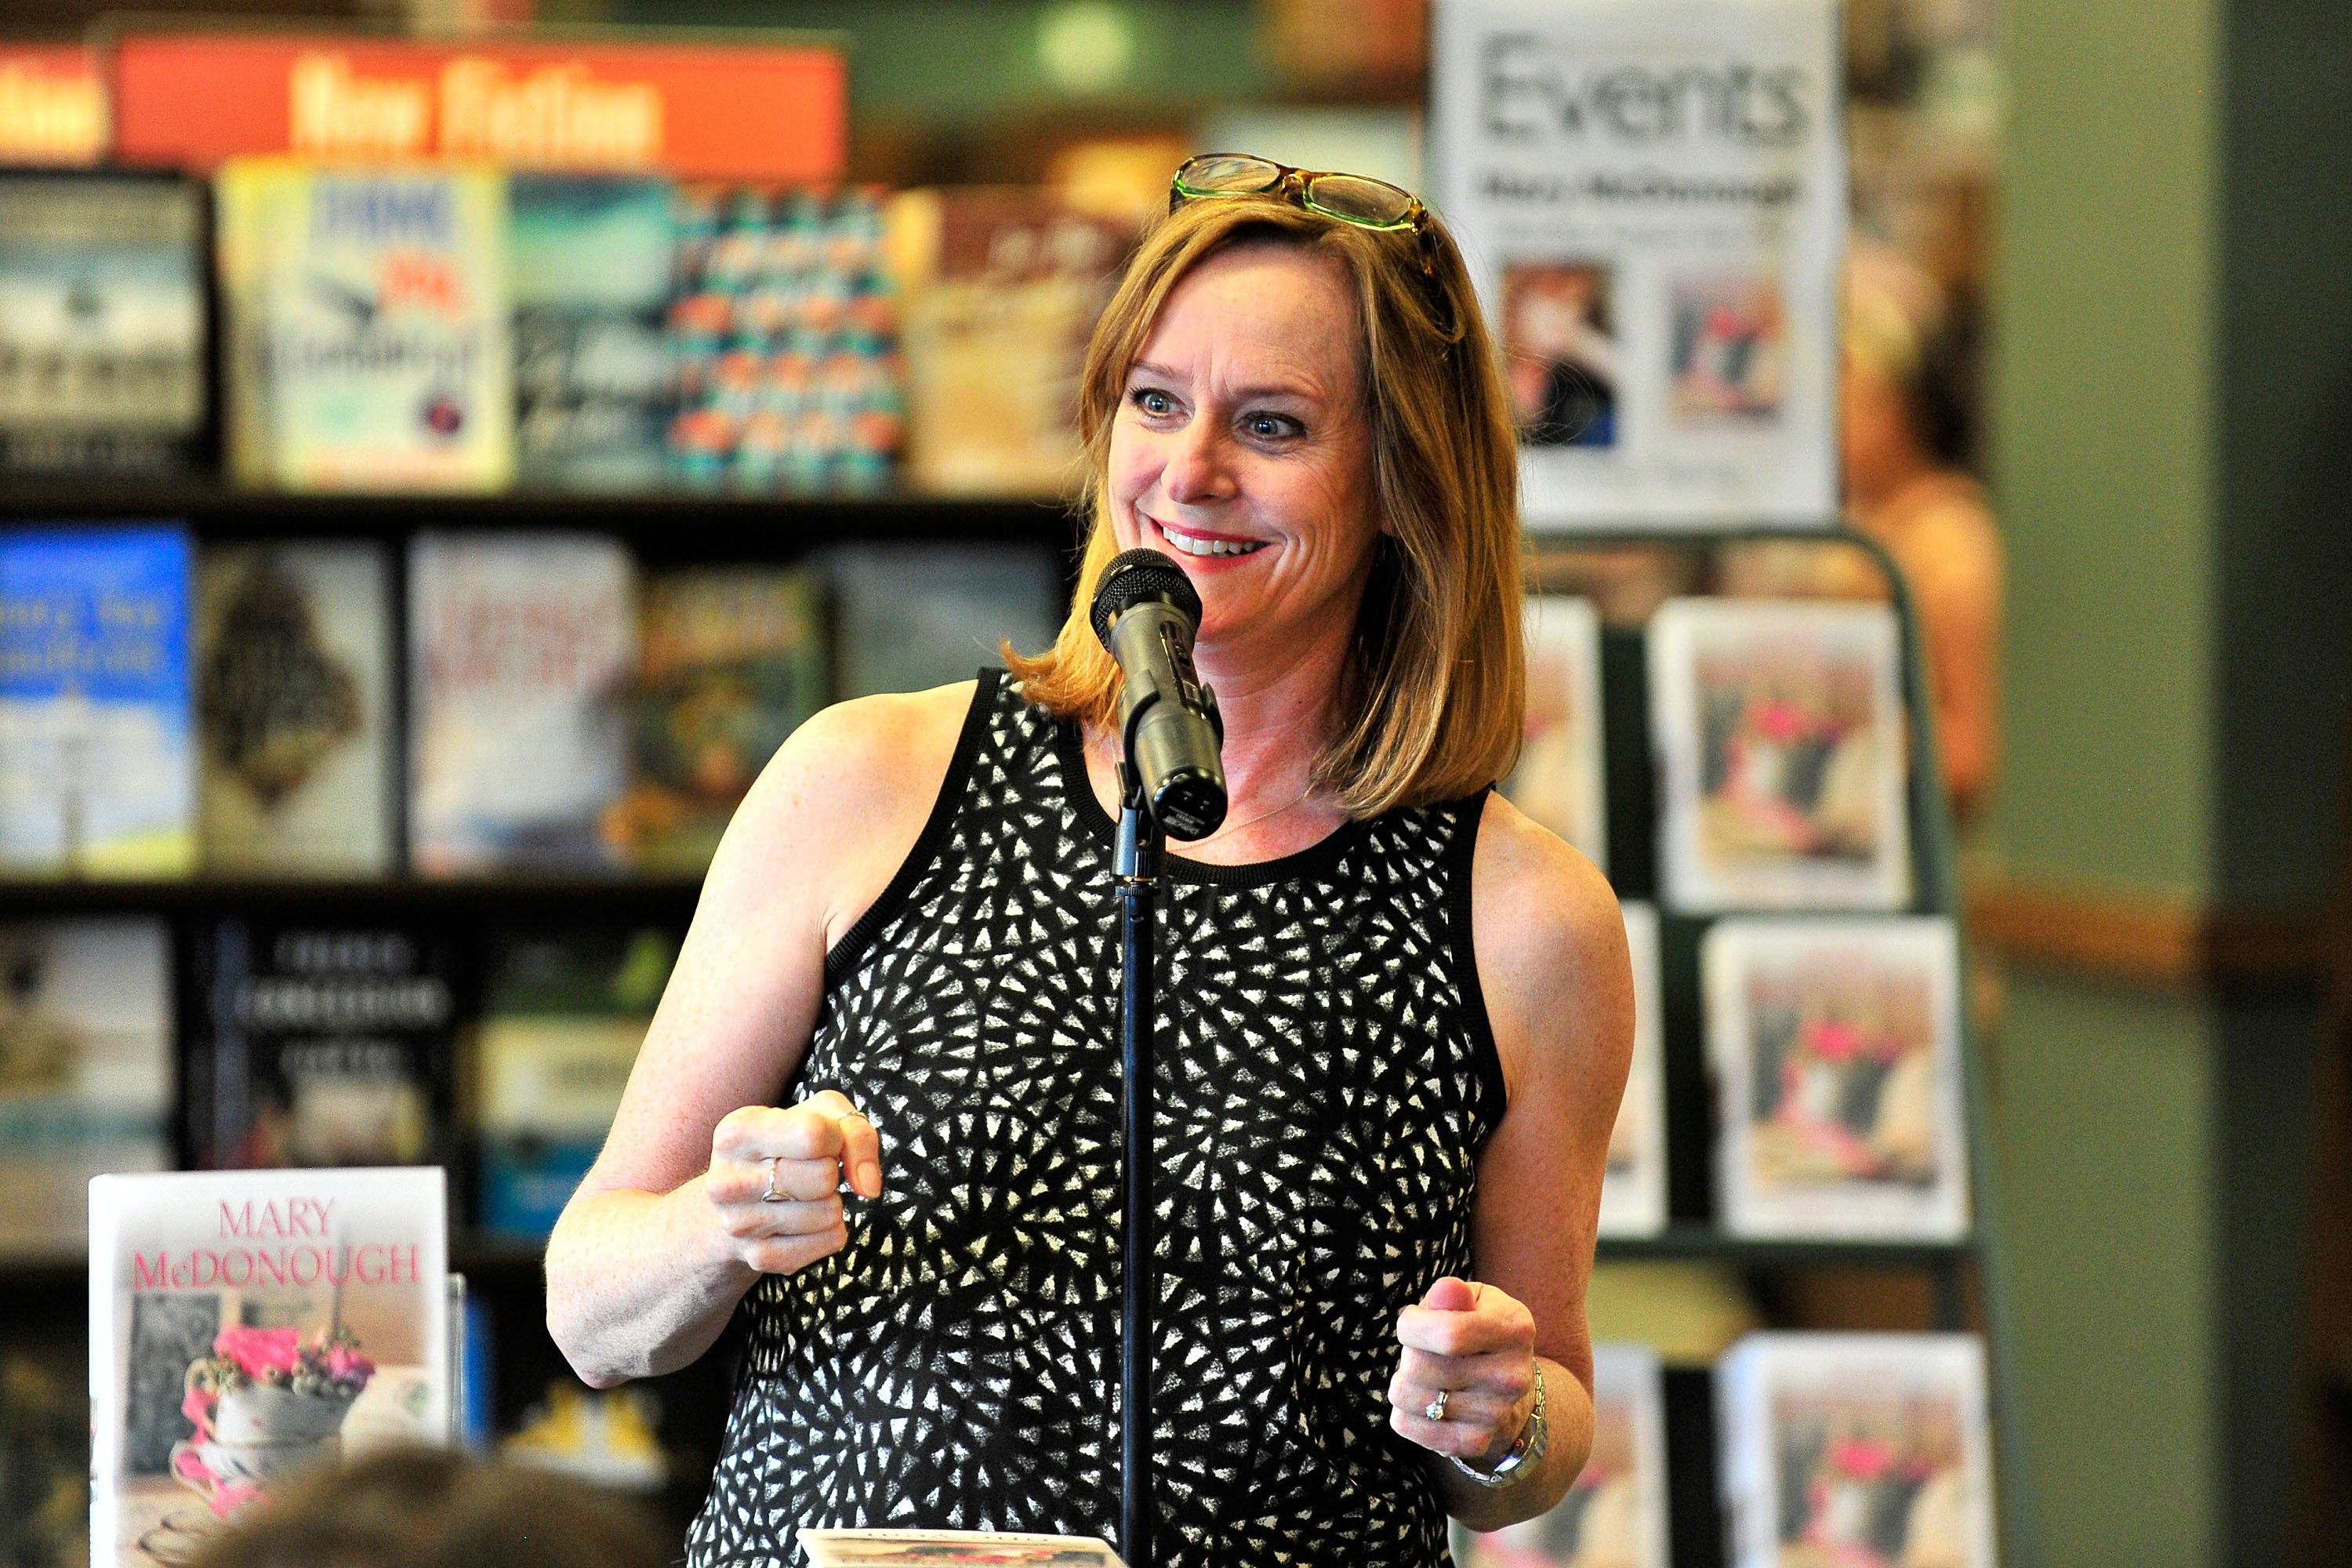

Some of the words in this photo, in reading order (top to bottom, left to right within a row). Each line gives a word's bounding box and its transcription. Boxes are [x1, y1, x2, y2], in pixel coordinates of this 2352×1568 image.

[1484, 33, 1808, 143] Events
[220, 1196, 335, 1240] MARY
[132, 1243, 422, 1290] McDONOUGH
